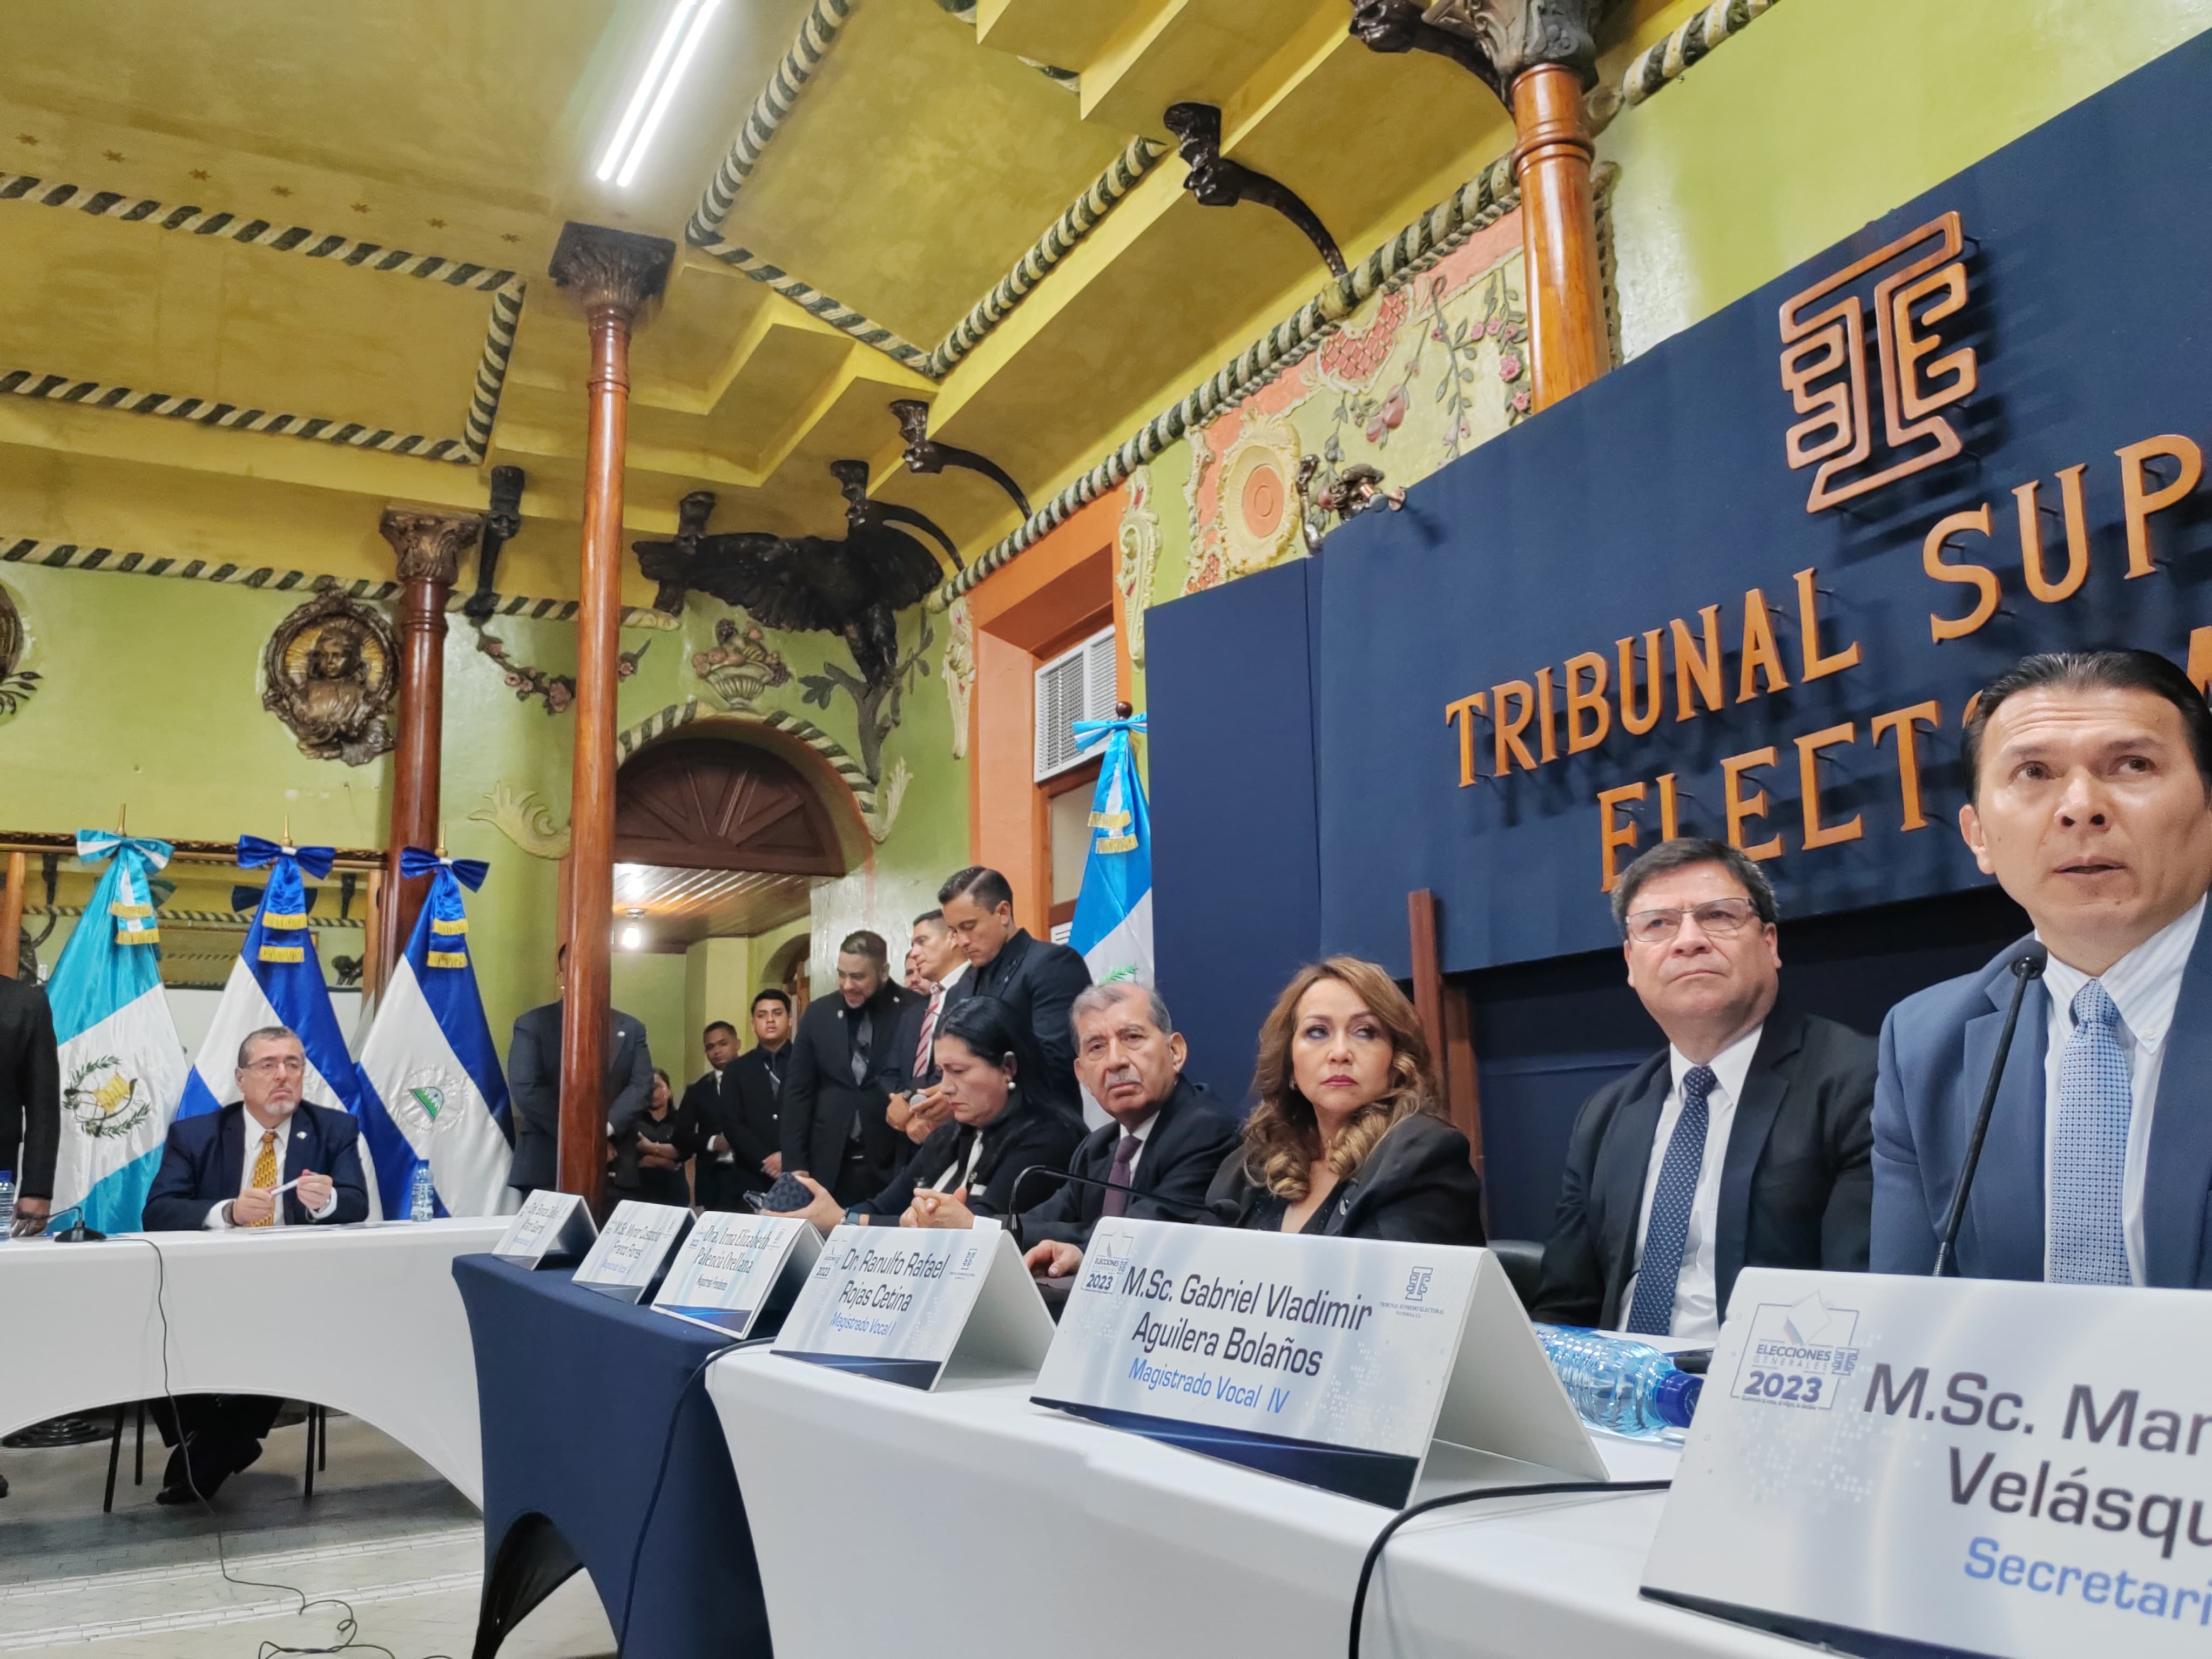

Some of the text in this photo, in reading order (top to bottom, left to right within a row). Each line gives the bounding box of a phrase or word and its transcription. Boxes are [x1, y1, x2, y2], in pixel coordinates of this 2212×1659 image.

[1446, 434, 2202, 789] TRIBUNAL SUP
[718, 1228, 738, 1246] Irma
[734, 1229, 772, 1250] Elizabeth
[694, 1247, 754, 1274] Palencia Orellana
[841, 1248, 950, 1279] Dr. Ranulfo Rafael
[838, 1280, 913, 1312] Rojas Cetina
[1085, 1273, 1114, 1291] 2023
[1122, 1266, 1373, 1331] M.Sc. Gabriel Vladimir
[830, 1312, 896, 1336] Magistrado Vocal I
[1131, 1311, 1324, 1377] Aguilera Bolaños
[1756, 1344, 1832, 1361] ELECCIONES
[1754, 1355, 1829, 1372] GENERALES
[1128, 1357, 1291, 1414] Magistrado Vocal IV
[1744, 1370, 1823, 1402] 2023
[1863, 1363, 2212, 1455] M.Sc. Mar
